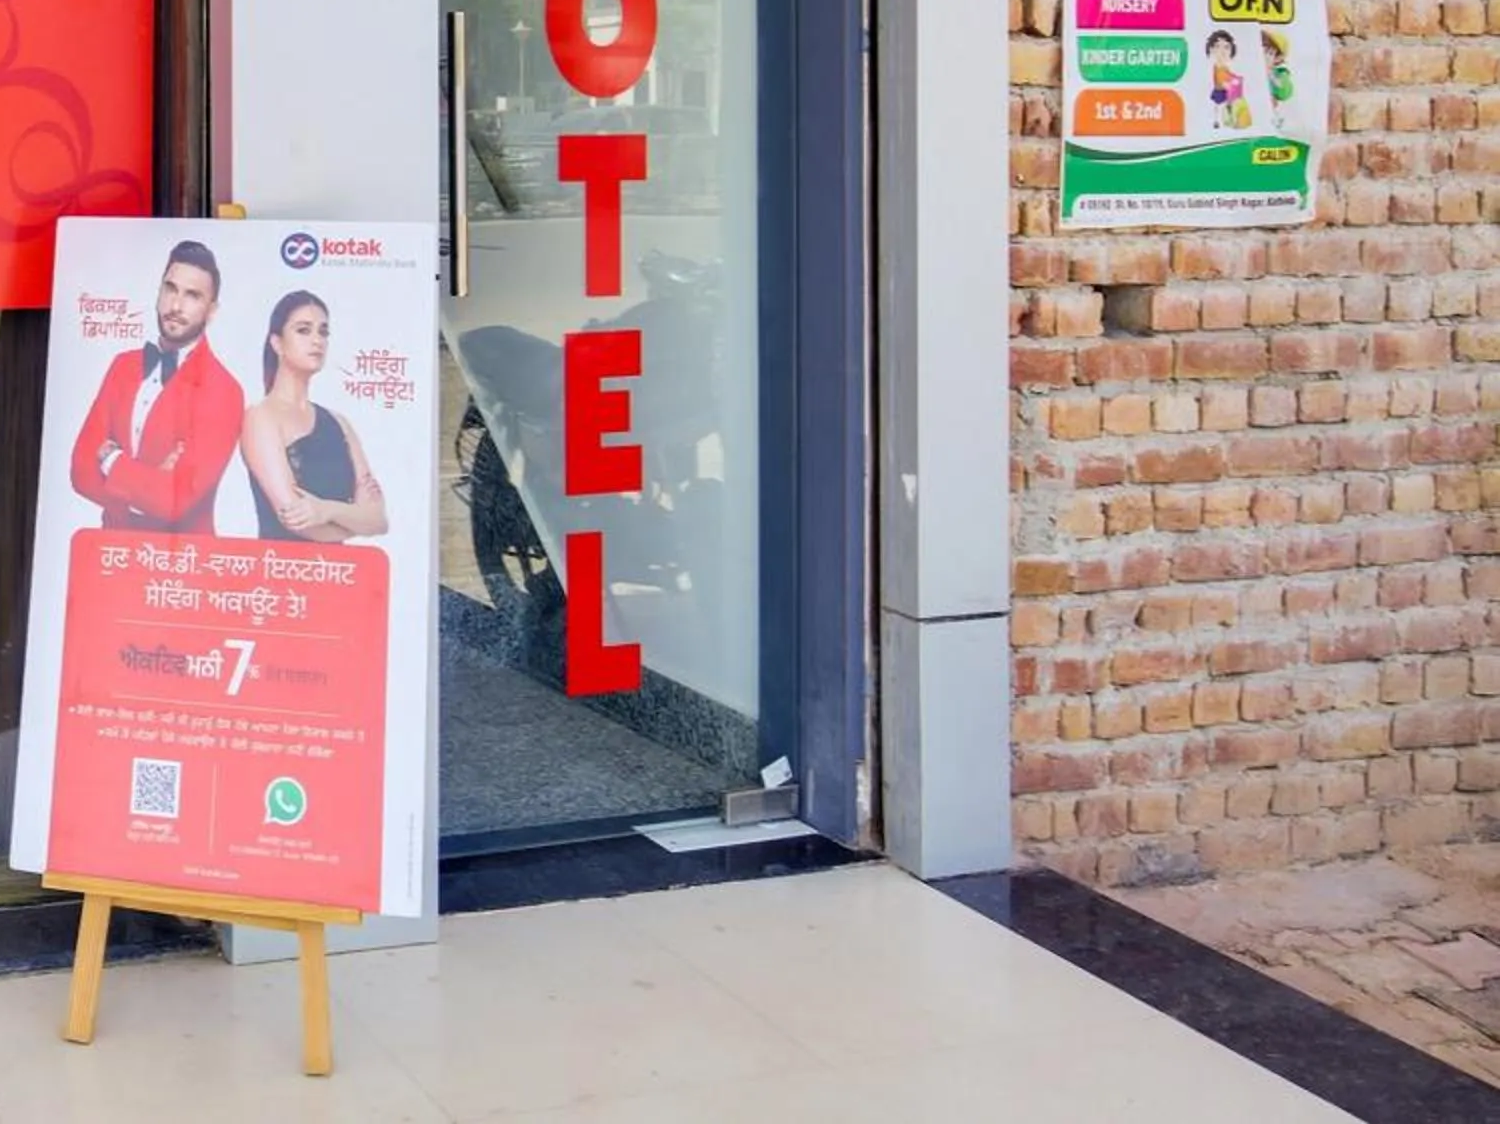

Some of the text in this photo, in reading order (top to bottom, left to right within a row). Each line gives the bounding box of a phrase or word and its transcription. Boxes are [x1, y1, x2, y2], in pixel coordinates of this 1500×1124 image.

[1081, 49, 1180, 66] KINDER GARTEN
[1095, 101, 1118, 120] 1st
[1134, 100, 1162, 120] 2nd
[322, 237, 382, 257] kotak
[100, 546, 130, 574] ਹੁਣ
